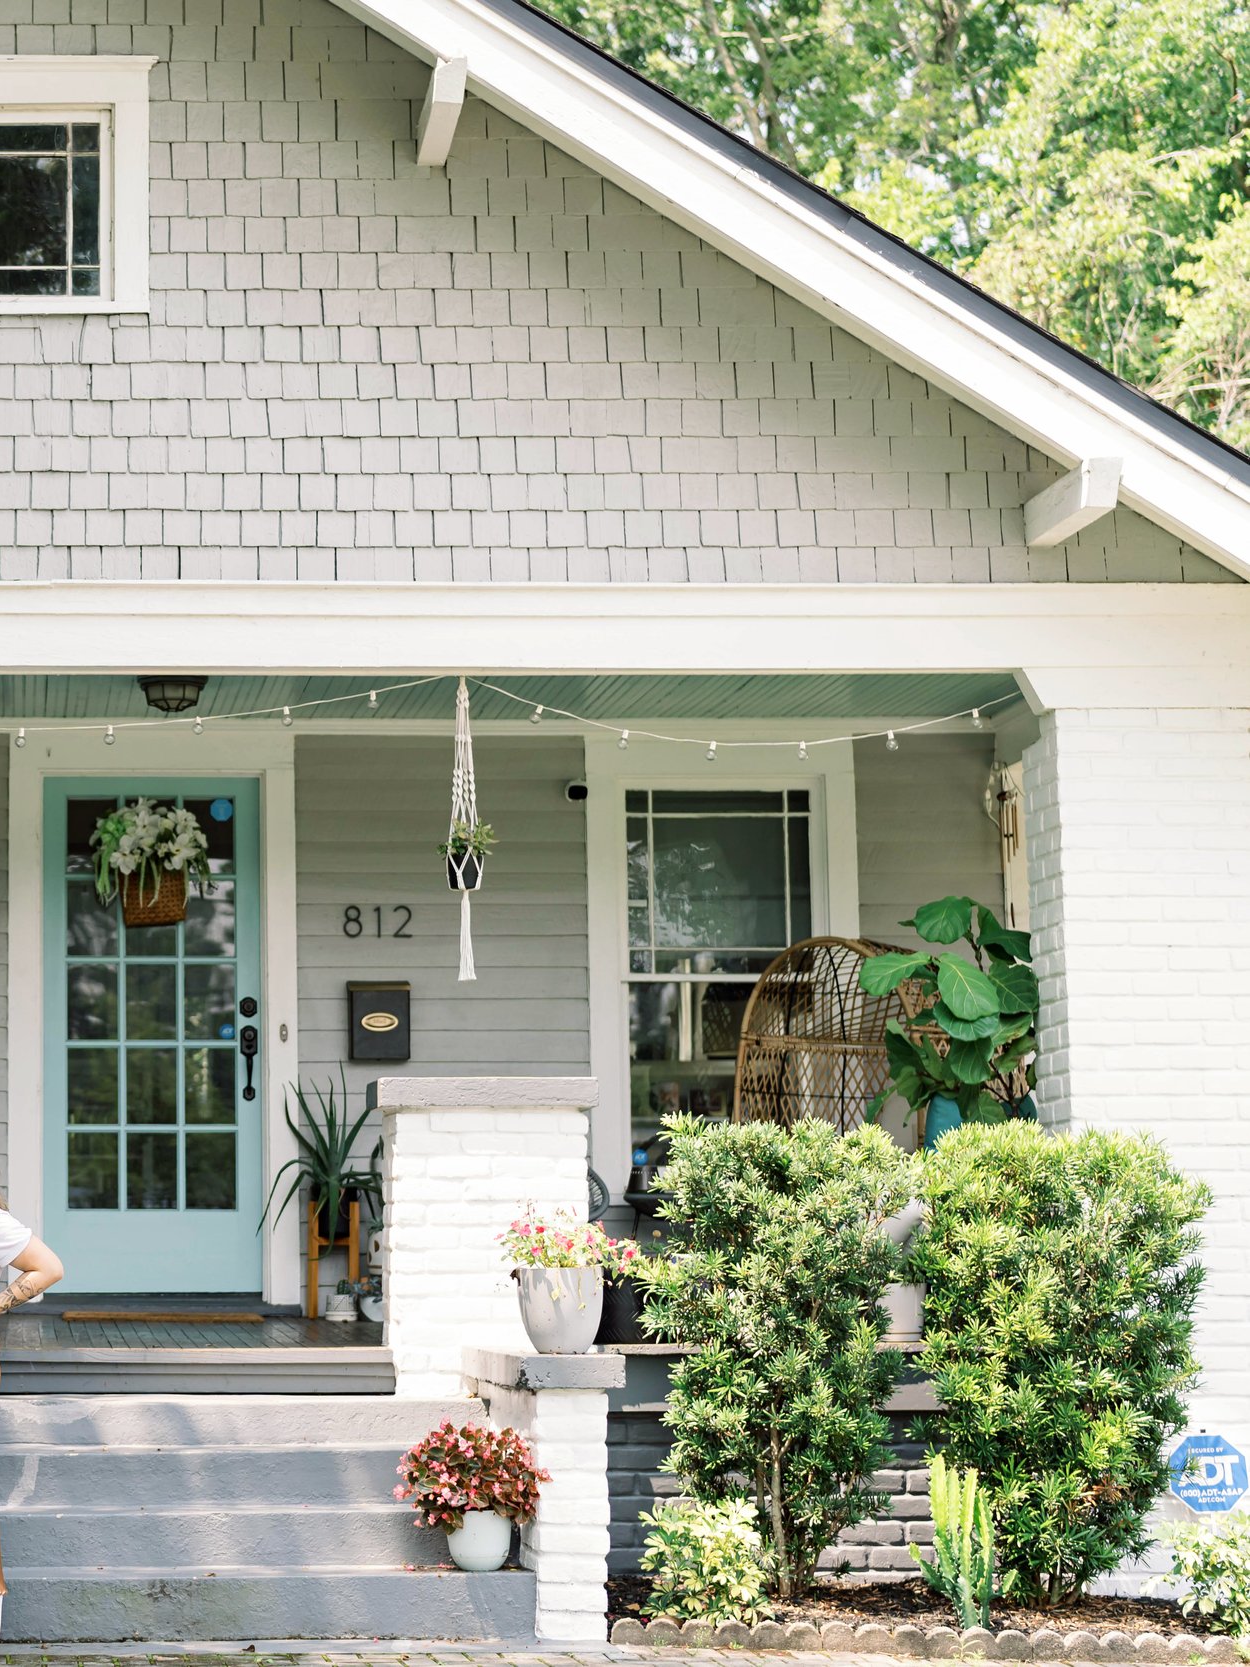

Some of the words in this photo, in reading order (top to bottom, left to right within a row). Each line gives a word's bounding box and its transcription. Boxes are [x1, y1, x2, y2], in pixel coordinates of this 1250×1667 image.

[343, 905, 413, 938] 812
[1178, 1455, 1239, 1487] ADT
[1180, 1489, 1200, 1498] (800)
[1201, 1488, 1243, 1497] ADT-ASAP
